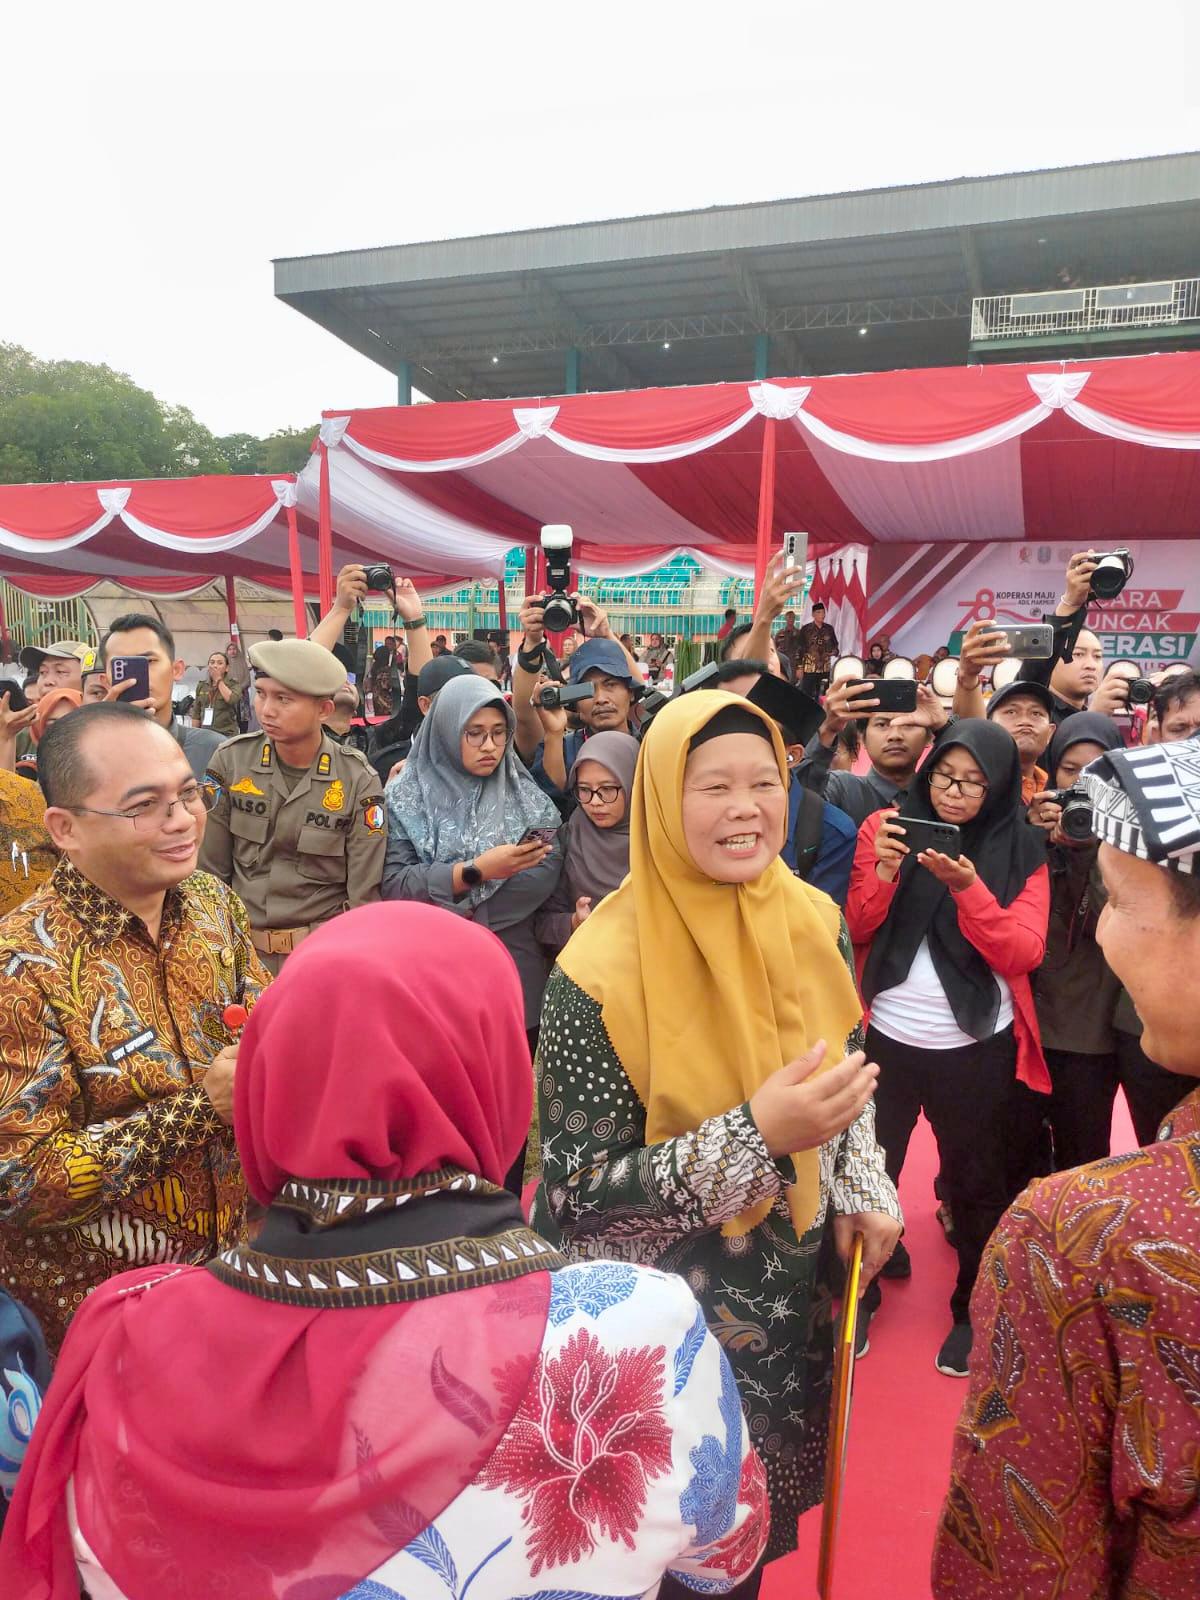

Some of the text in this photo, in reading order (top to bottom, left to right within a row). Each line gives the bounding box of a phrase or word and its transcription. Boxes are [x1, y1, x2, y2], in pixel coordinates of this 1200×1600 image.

[996, 591, 1056, 600] KOPERASI MAJU
[1086, 613, 1172, 631] UNCAK
[1099, 635, 1187, 657] ERASI
[305, 811, 331, 828] POL
